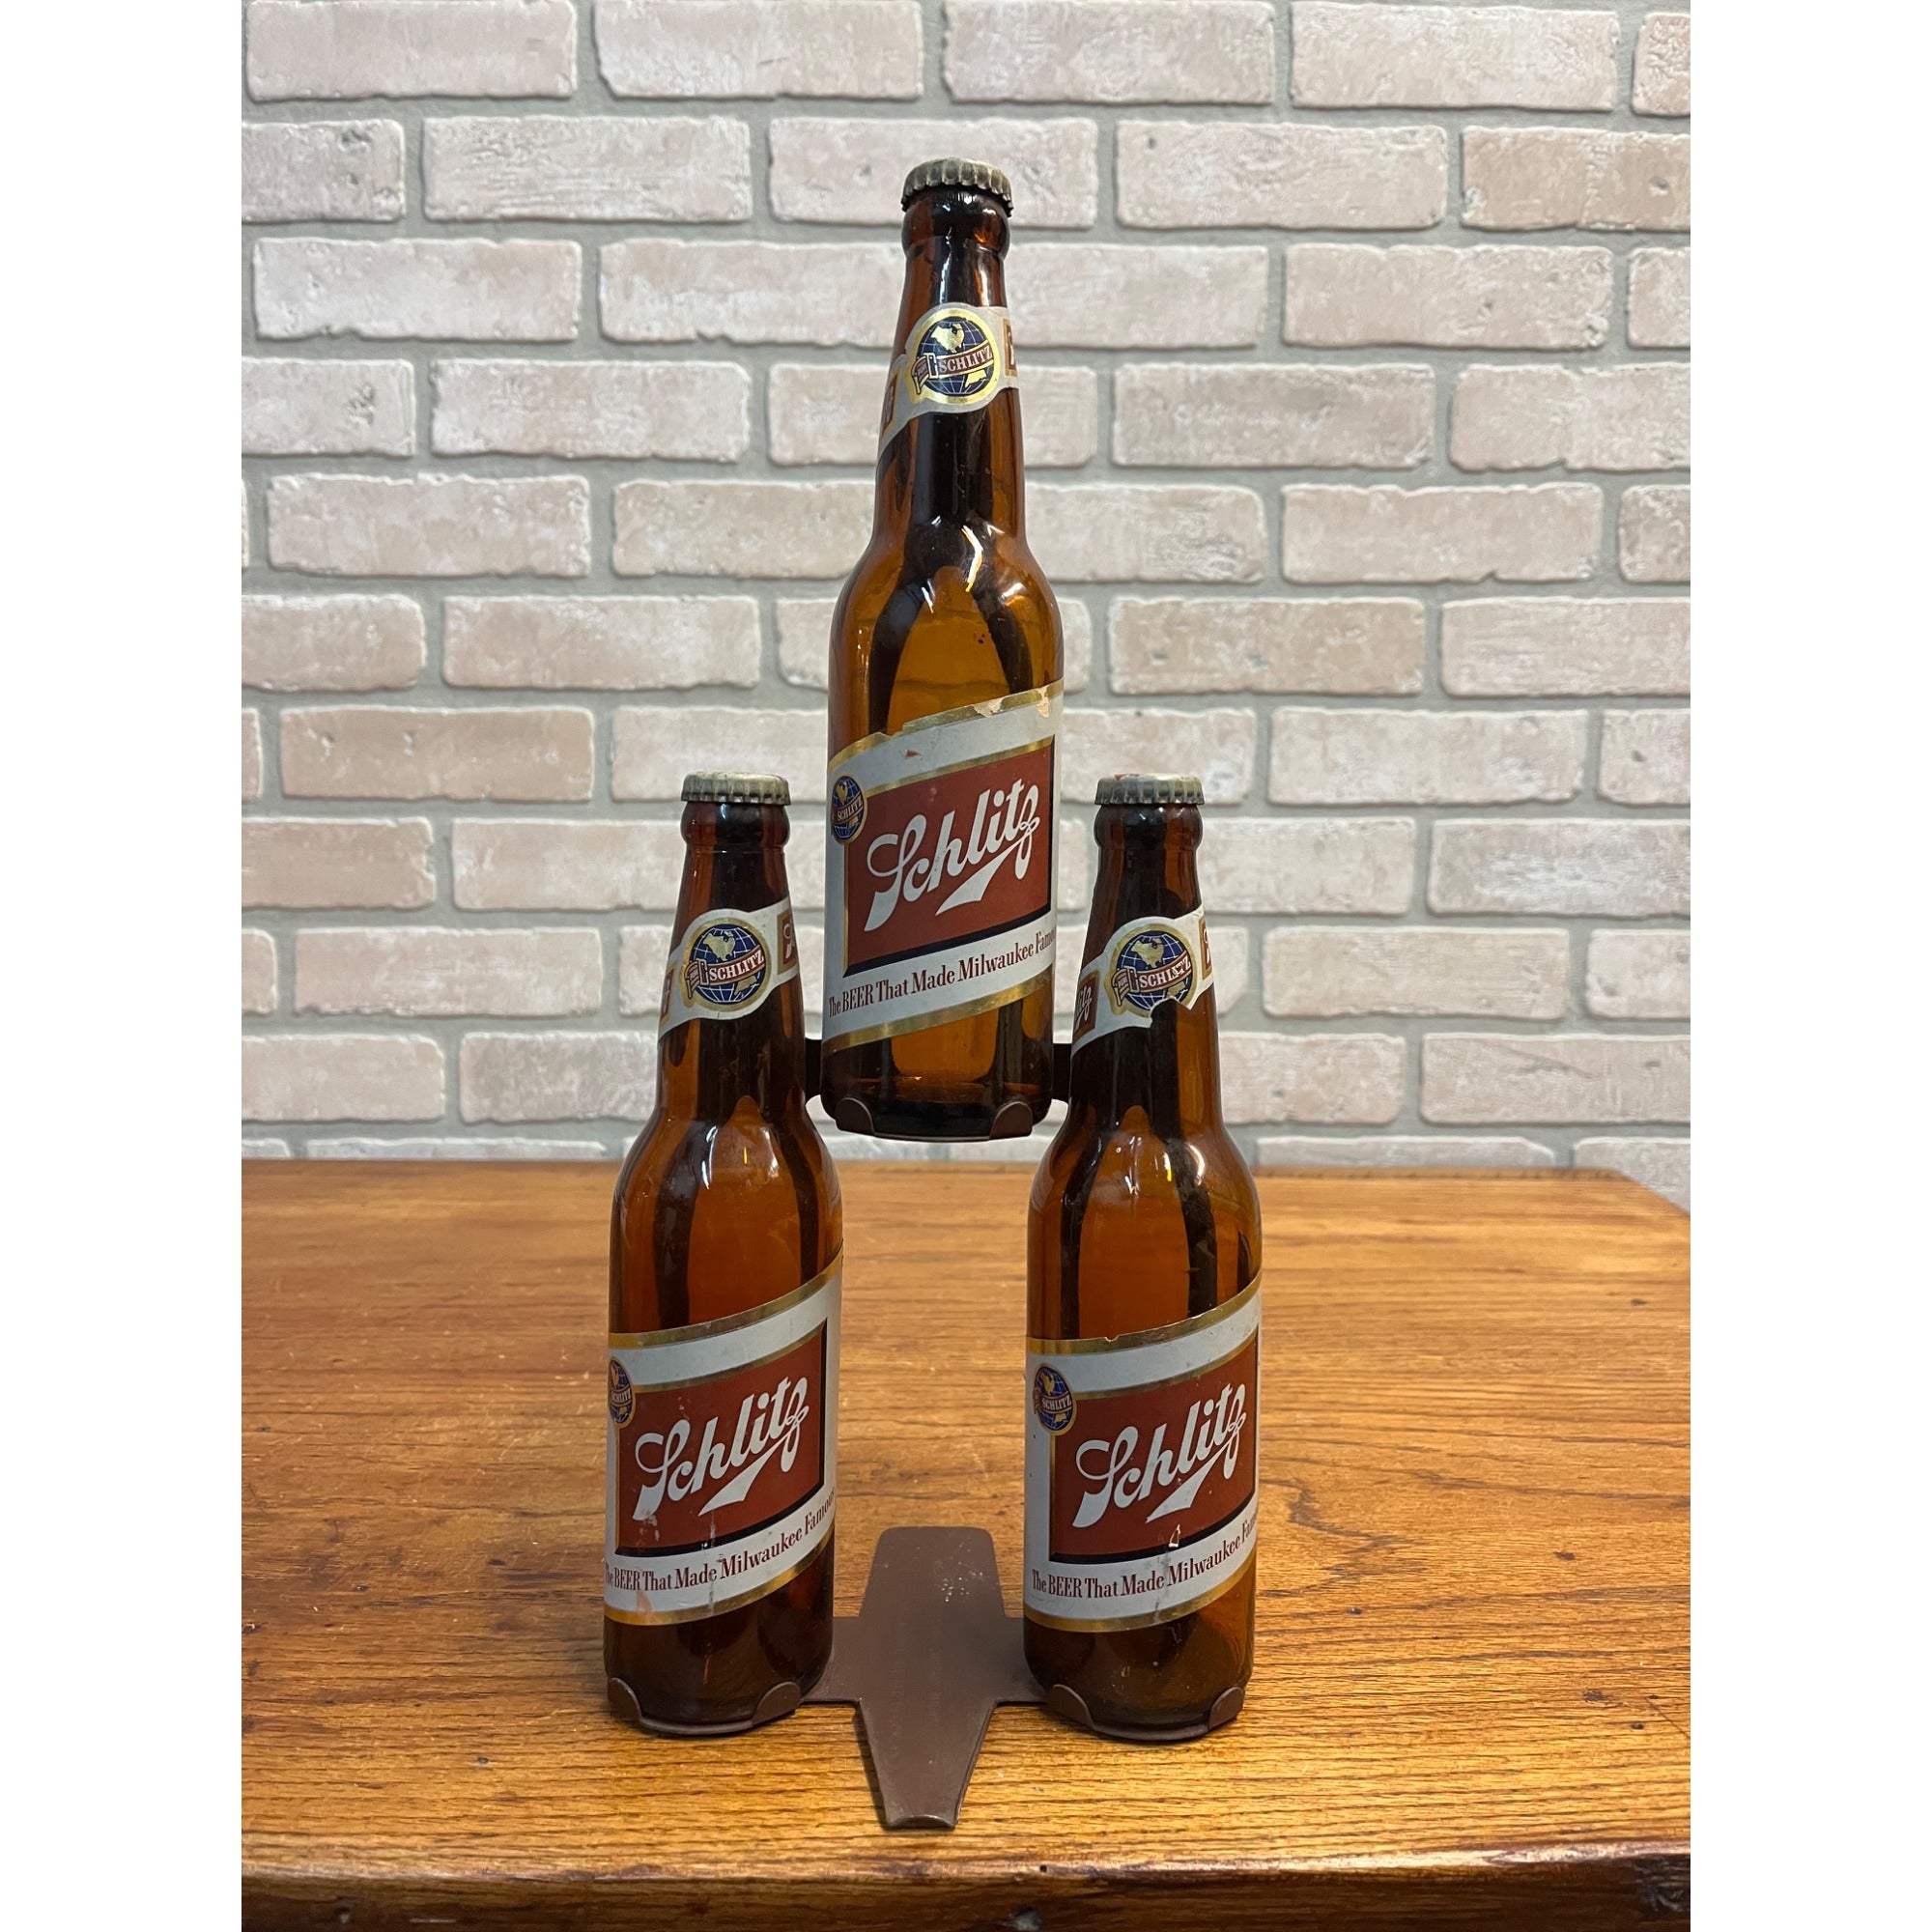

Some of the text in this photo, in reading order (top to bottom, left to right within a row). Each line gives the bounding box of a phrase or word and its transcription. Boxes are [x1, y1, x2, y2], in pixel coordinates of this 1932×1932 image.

[938, 346, 993, 374] SCHLITZ
[864, 778, 1041, 932] Schlitz
[708, 949, 765, 981] SCHLITZ
[841, 983, 874, 1012] BEER
[875, 979, 909, 1003] That
[910, 964, 955, 995] Made
[957, 943, 1035, 982] Milwaukee
[1042, 1394, 1072, 1410] SCHLITZ
[632, 1376, 810, 1520] Schlitz
[1071, 1382, 1248, 1528] Schlitz
[613, 1567, 641, 1591] BEER
[641, 1570, 672, 1591] That
[673, 1563, 718, 1589] Made
[719, 1527, 803, 1579] Milwaukee
[1031, 1569, 1048, 1592] The
[1048, 1574, 1083, 1599] BEER
[1084, 1577, 1119, 1599] That
[1120, 1570, 1165, 1597] Made
[1166, 1535, 1241, 1586] Milwaukee
